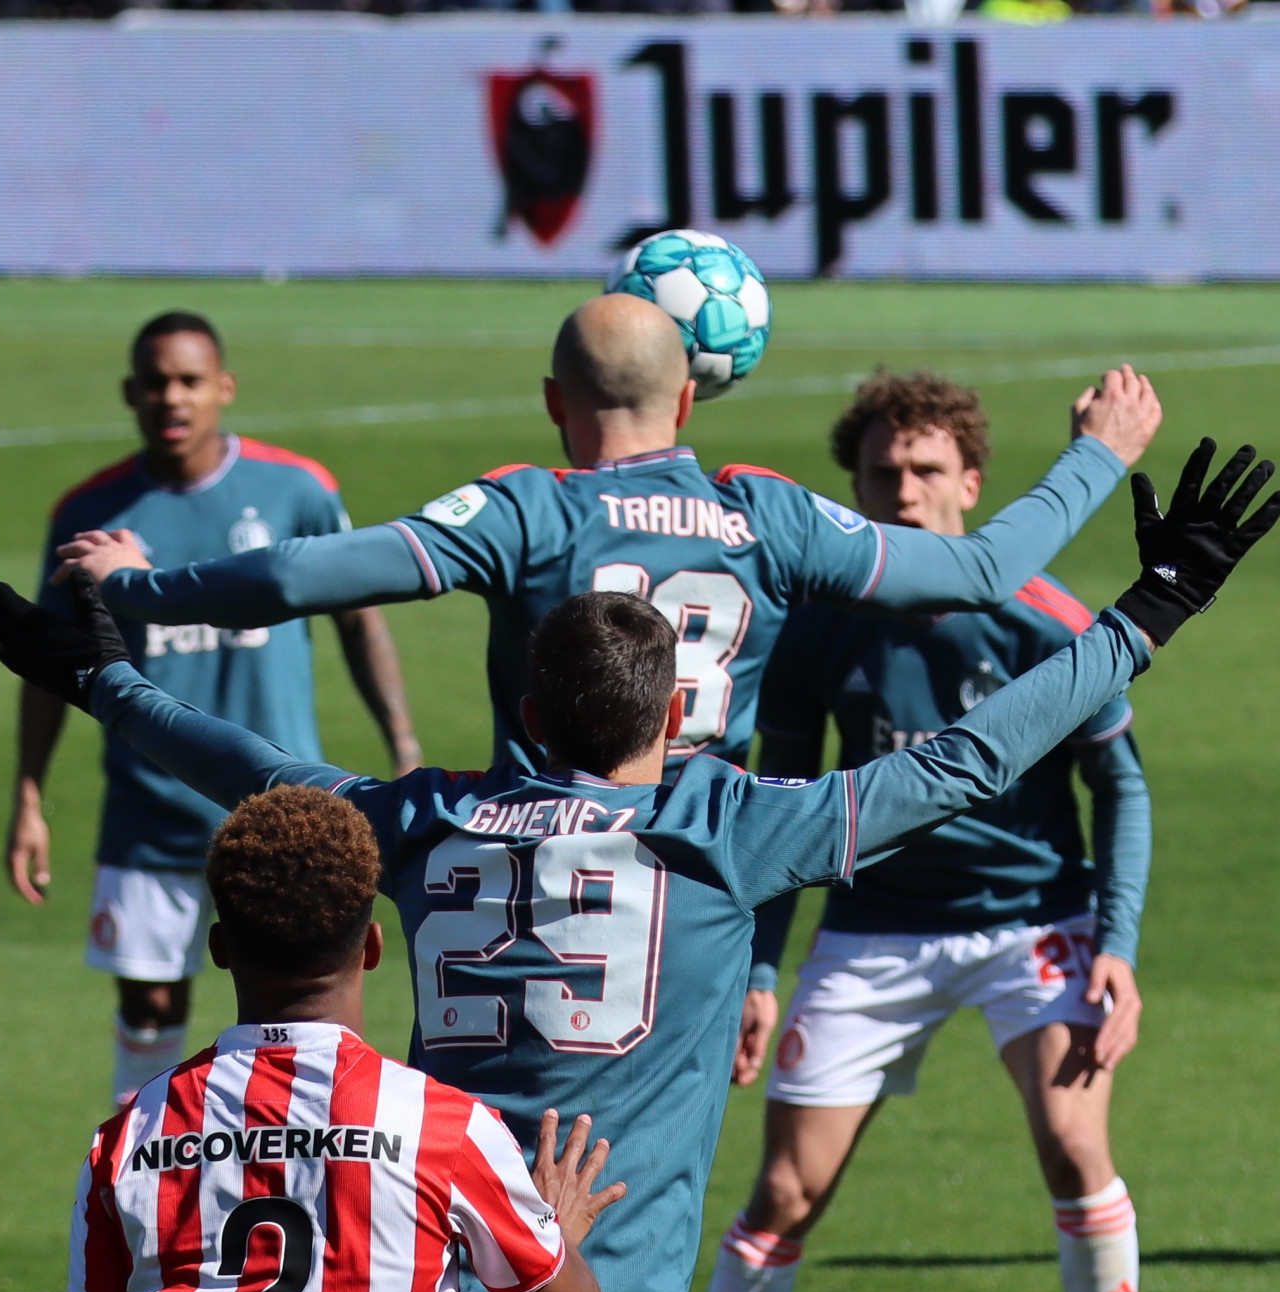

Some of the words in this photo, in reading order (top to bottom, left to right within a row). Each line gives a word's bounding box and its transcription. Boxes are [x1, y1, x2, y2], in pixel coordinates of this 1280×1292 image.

[615, 36, 1175, 279] Jupiler
[598, 494, 757, 547] TRAUNR
[414, 832, 666, 1055] 29
[263, 1028, 288, 1043] 135
[132, 1128, 402, 1171] NICOVERKEN
